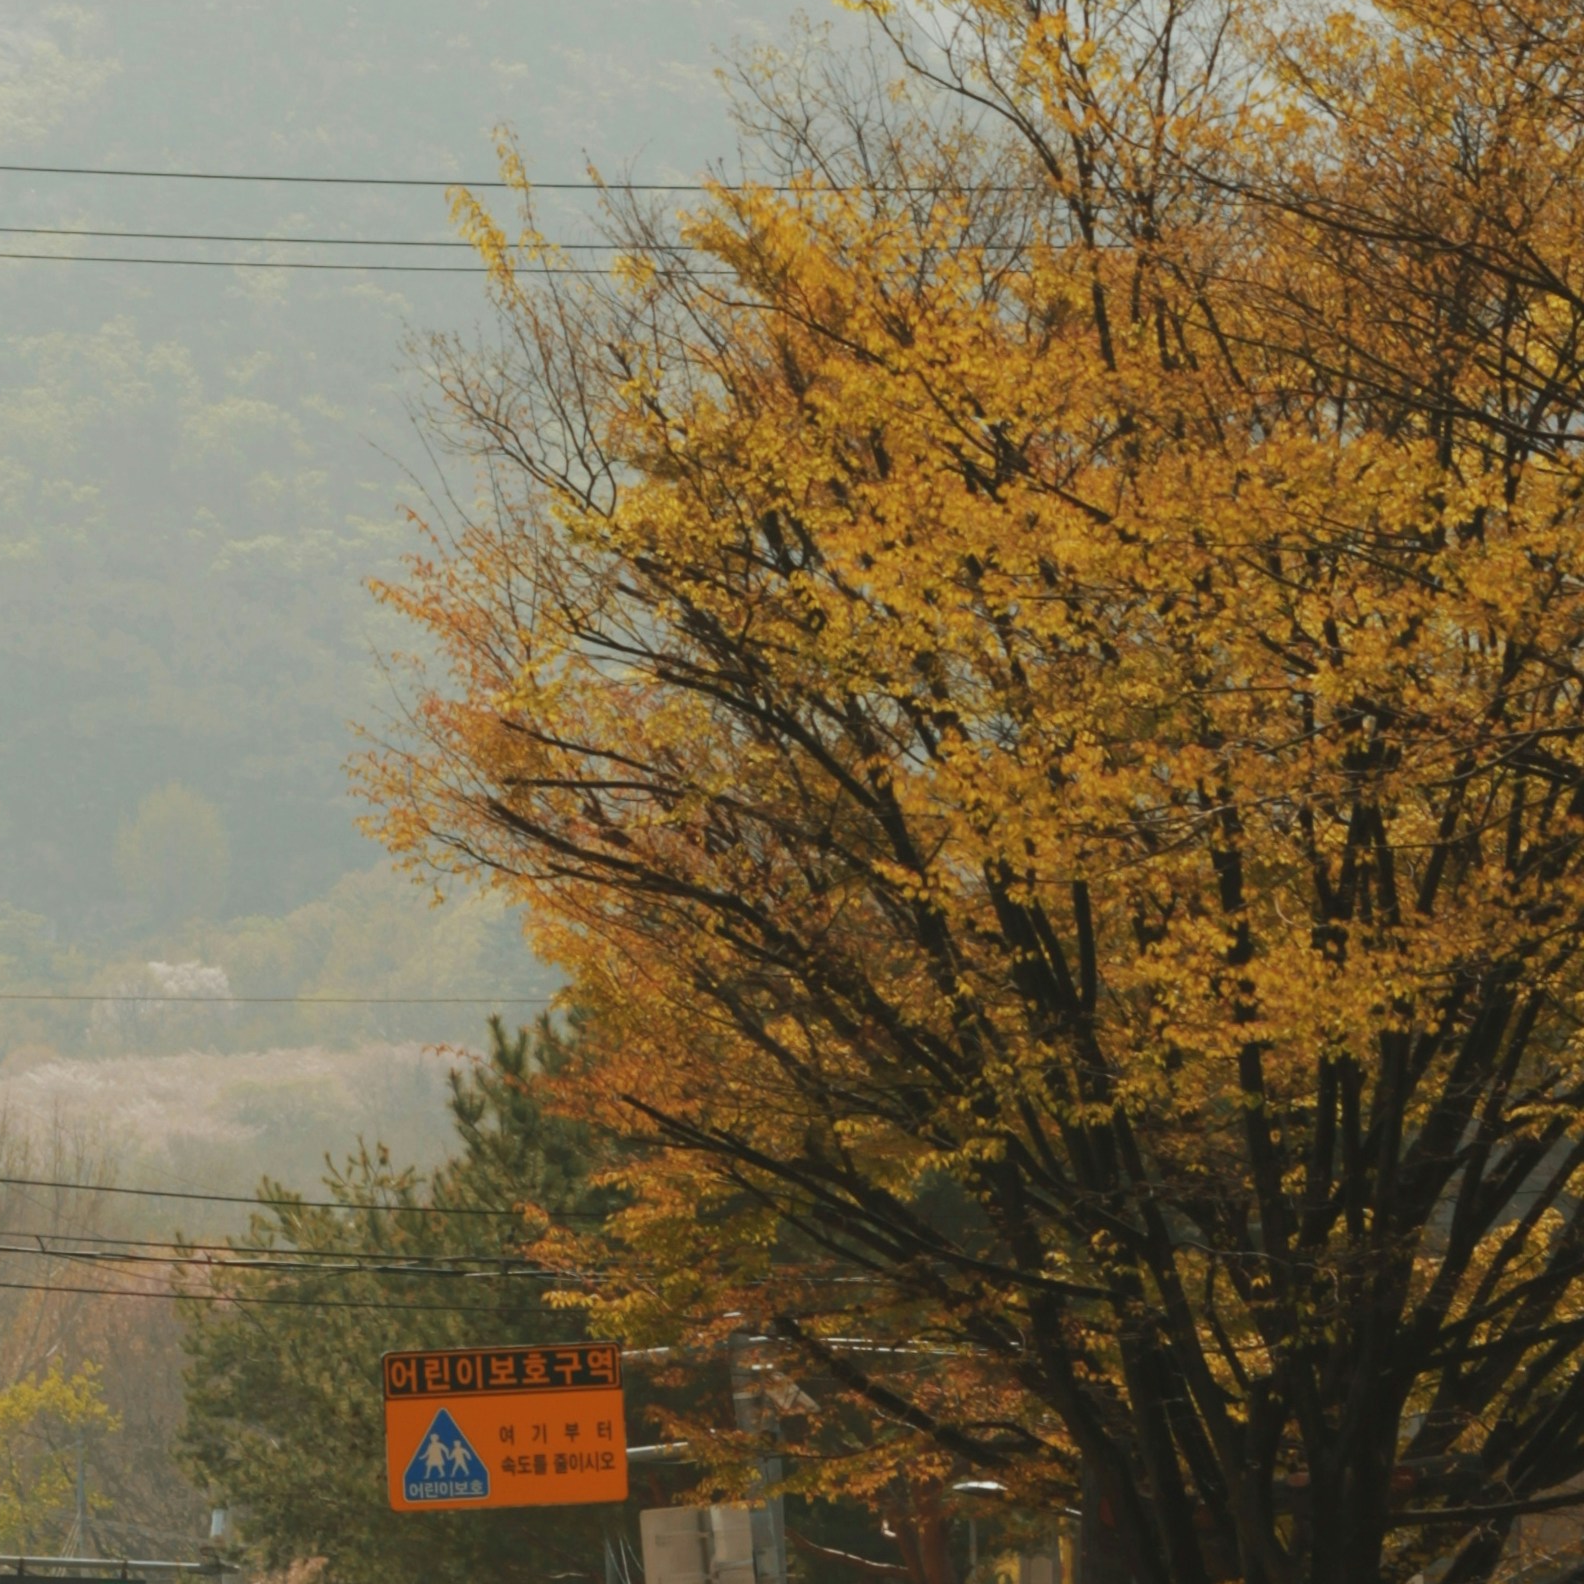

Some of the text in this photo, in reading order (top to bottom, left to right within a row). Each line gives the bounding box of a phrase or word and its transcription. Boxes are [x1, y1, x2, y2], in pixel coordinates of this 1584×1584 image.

[391, 1348, 614, 1393] 어린이보호구역
[501, 1451, 615, 1476] 속도를 줄이시오
[409, 1480, 484, 1499] 어린이보호
